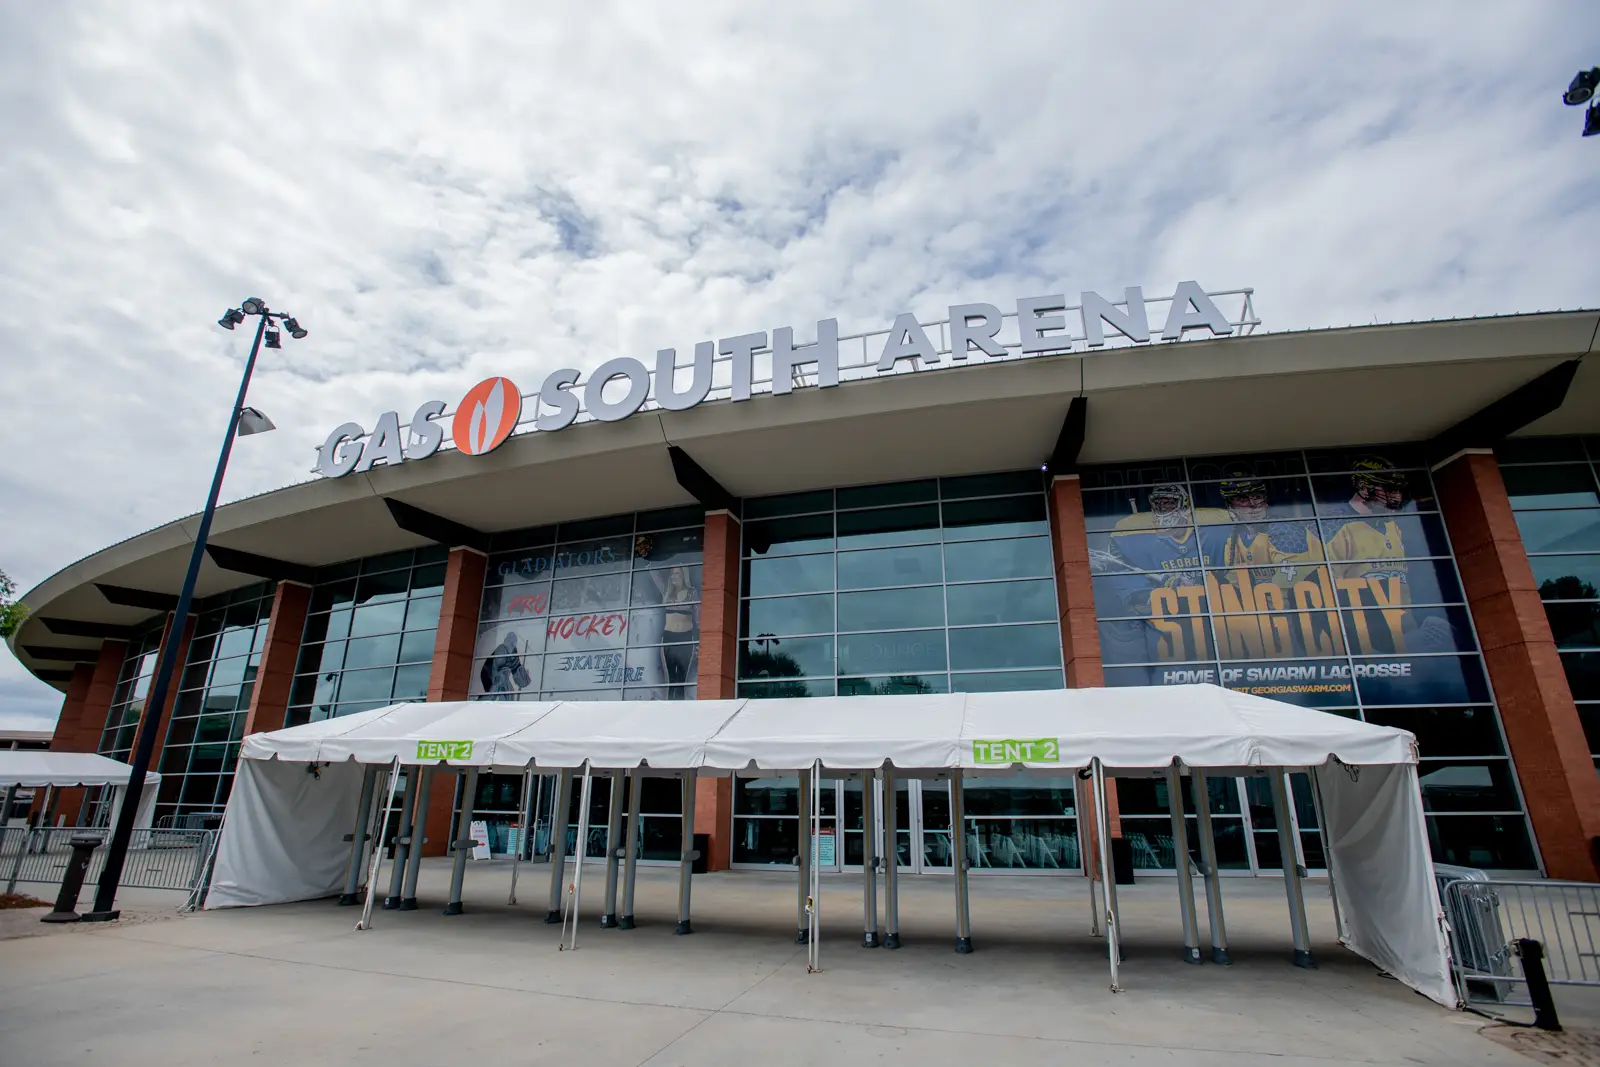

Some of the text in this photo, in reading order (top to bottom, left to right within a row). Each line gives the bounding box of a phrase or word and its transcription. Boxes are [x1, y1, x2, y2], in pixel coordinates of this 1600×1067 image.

[321, 280, 1234, 478] GAS SOUTH ARENA
[497, 548, 616, 576] GLADIATORS
[508, 591, 547, 615] PRO
[1150, 564, 1406, 660] STING CITY
[547, 614, 626, 641] HOCKEY
[563, 653, 622, 671] SKATES
[1163, 663, 1411, 684] HOME OF SWARM LACROSSE
[418, 743, 472, 757] TENT 2
[975, 742, 1058, 761] TENT 2
